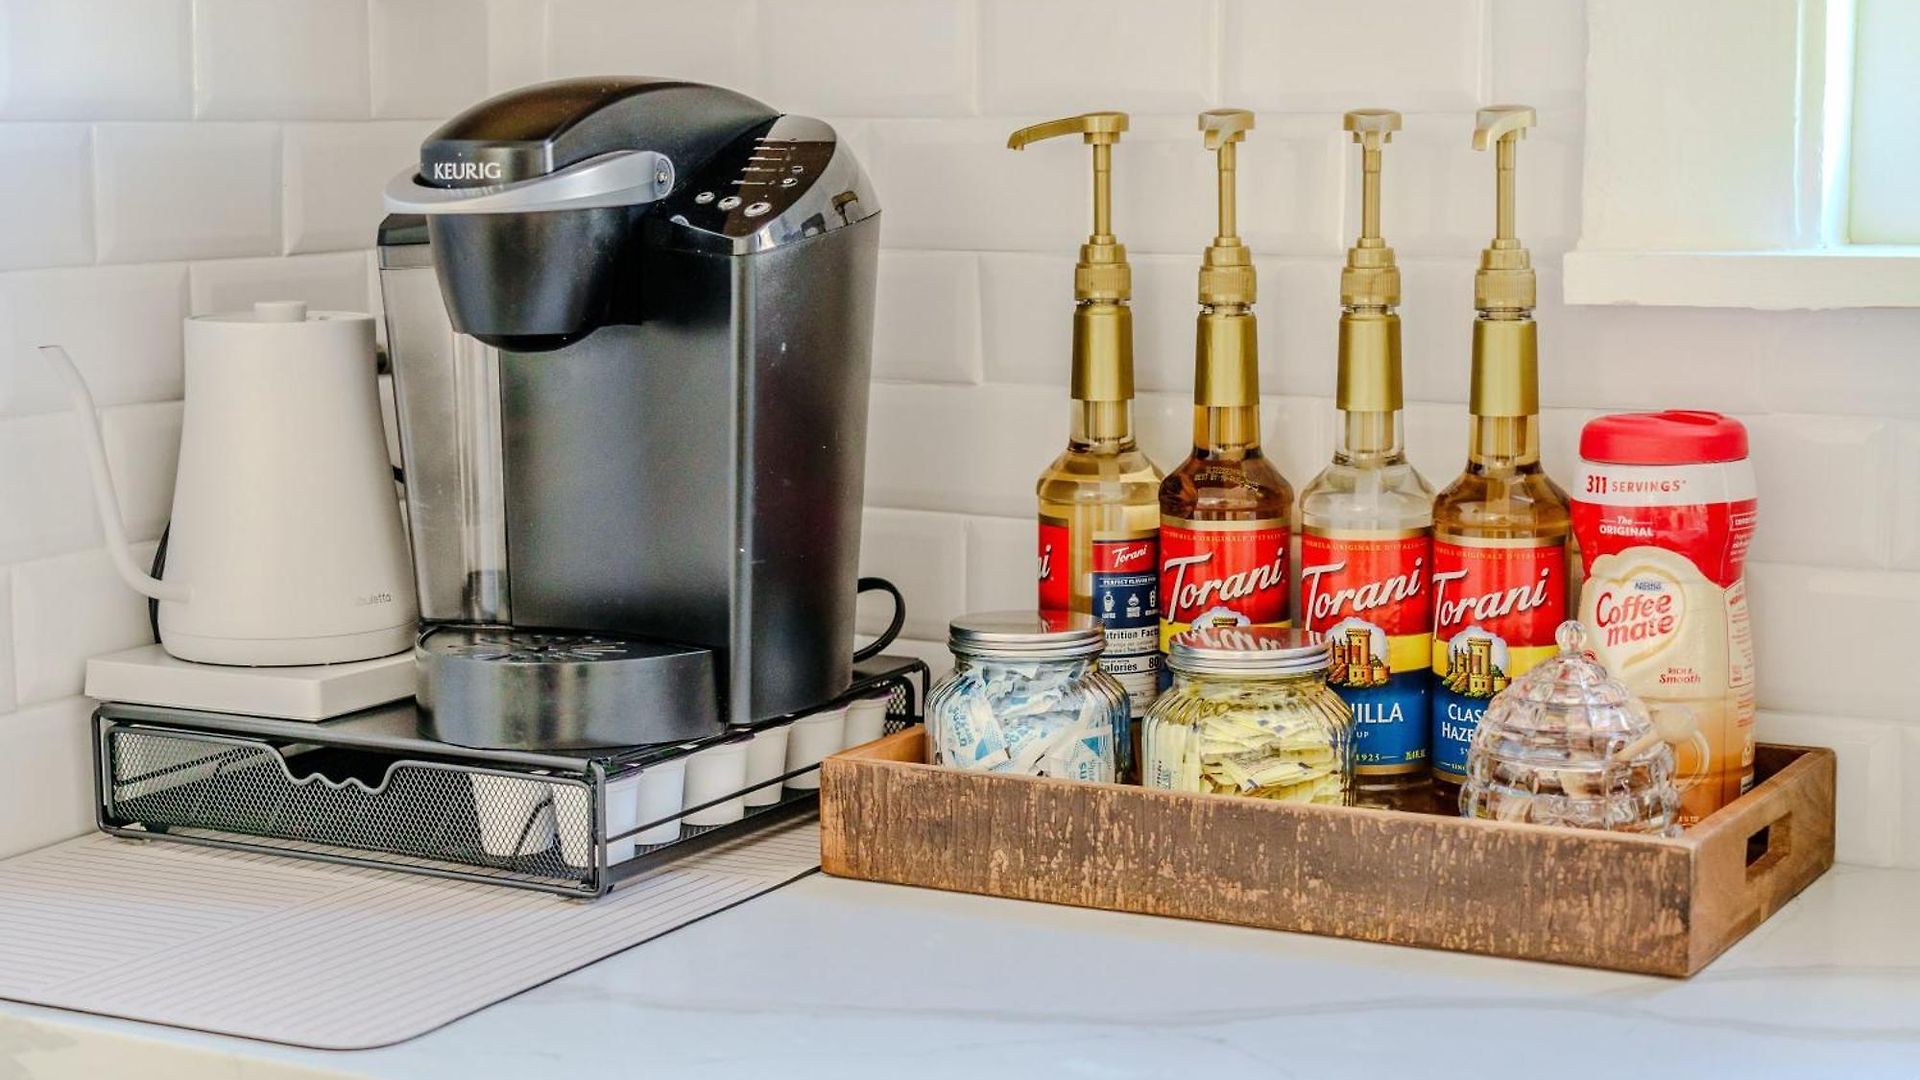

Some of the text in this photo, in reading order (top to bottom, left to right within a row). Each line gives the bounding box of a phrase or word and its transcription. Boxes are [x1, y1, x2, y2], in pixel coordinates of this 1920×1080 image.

[434, 162, 502, 180] KEURIG
[1586, 475, 1607, 494] 311
[1617, 515, 1633, 525] The
[1599, 524, 1655, 537] ORIGINAL
[1112, 544, 1148, 568] Torani
[1164, 547, 1283, 624] Torani
[1302, 557, 1423, 632] Torani
[1432, 567, 1550, 642] Torani
[1596, 592, 1672, 627] Coffee
[1106, 631, 1138, 640] trition
[1607, 615, 1674, 647] mate
[1101, 662, 1138, 672] alories
[1148, 656, 1159, 669] 80
[1659, 674, 1701, 684] Smooth
[1352, 703, 1404, 723] ILLA
[1442, 721, 1475, 742] HAZE
